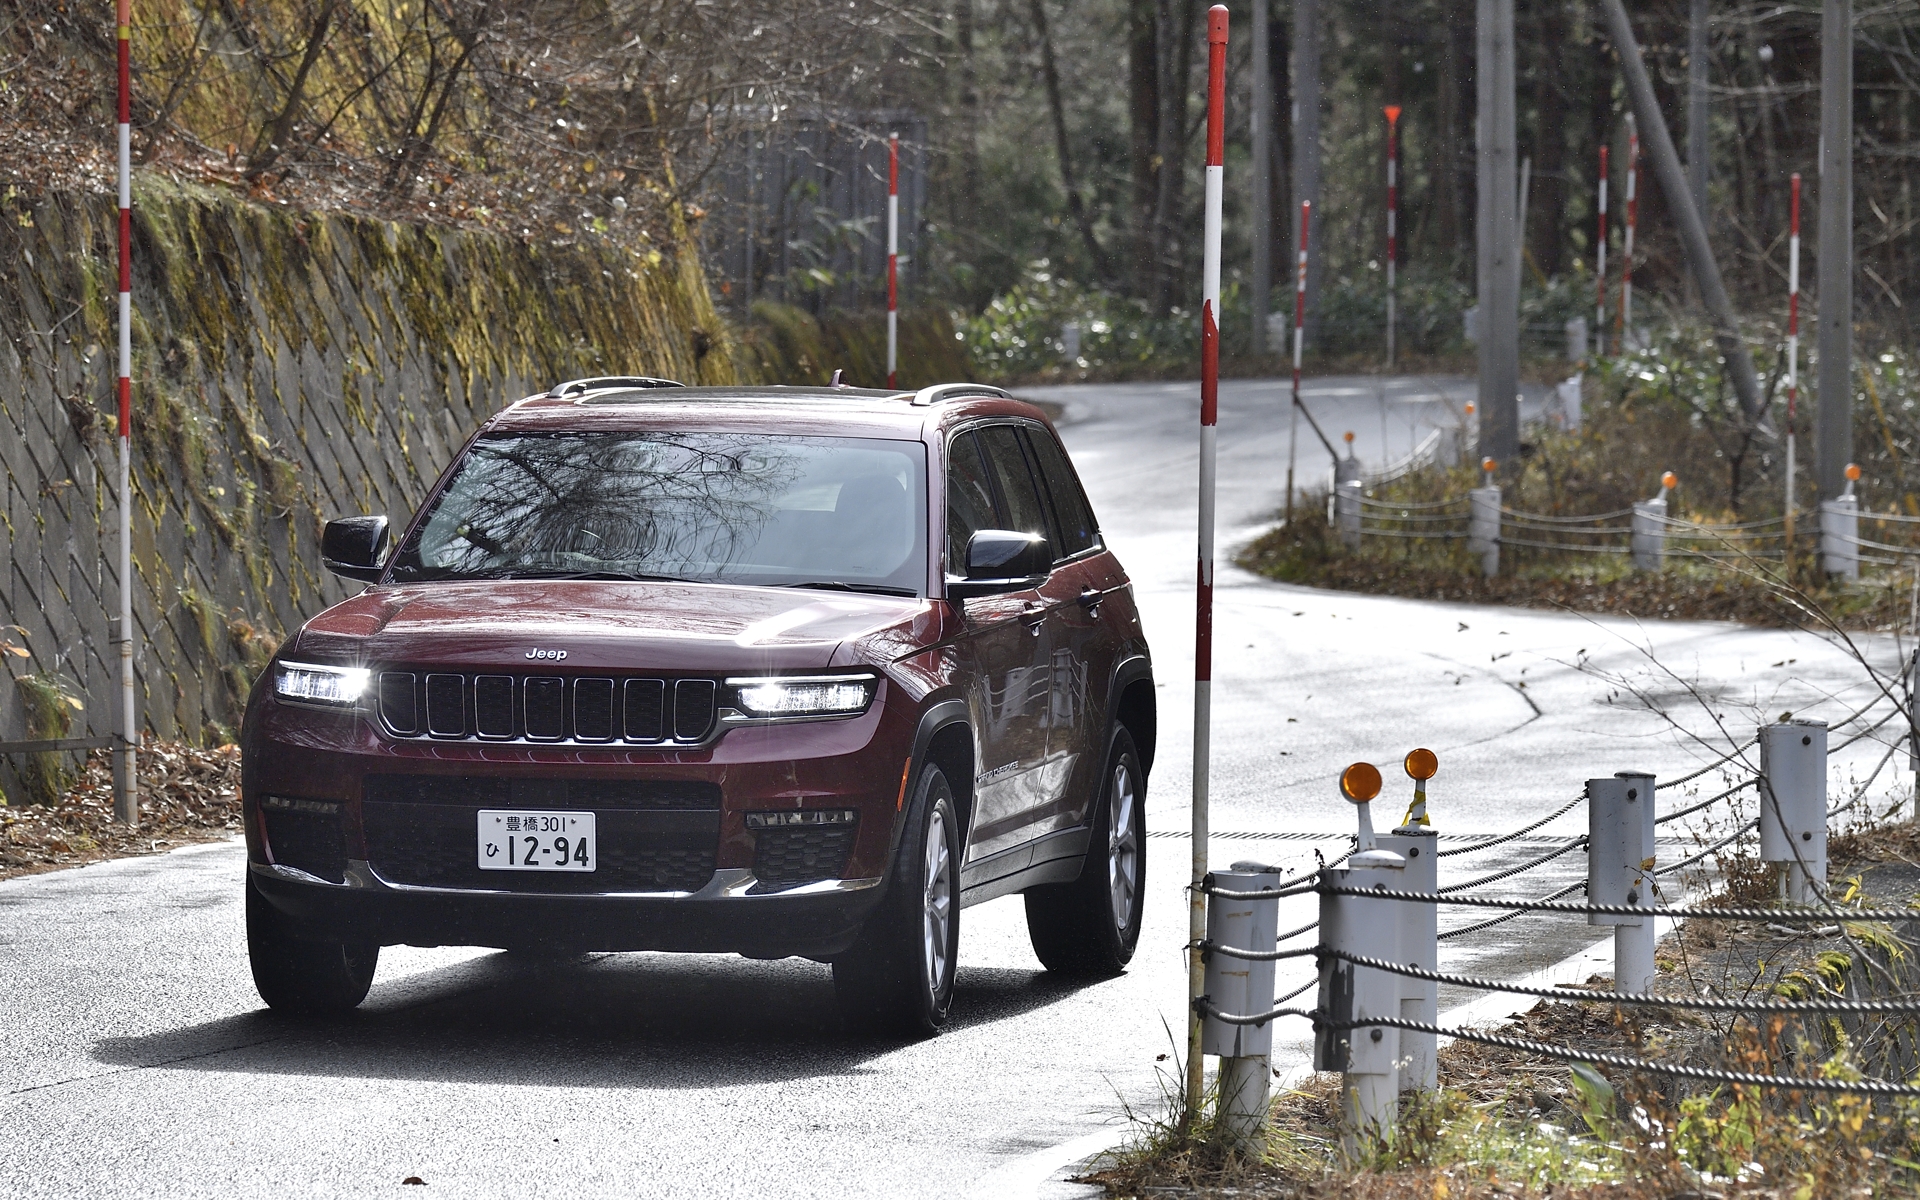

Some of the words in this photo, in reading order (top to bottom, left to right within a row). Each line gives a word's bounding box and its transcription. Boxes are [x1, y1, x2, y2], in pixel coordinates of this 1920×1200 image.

[525, 647, 568, 662] Jeep
[485, 842, 500, 858] ひ
[508, 835, 589, 867] 12-94
